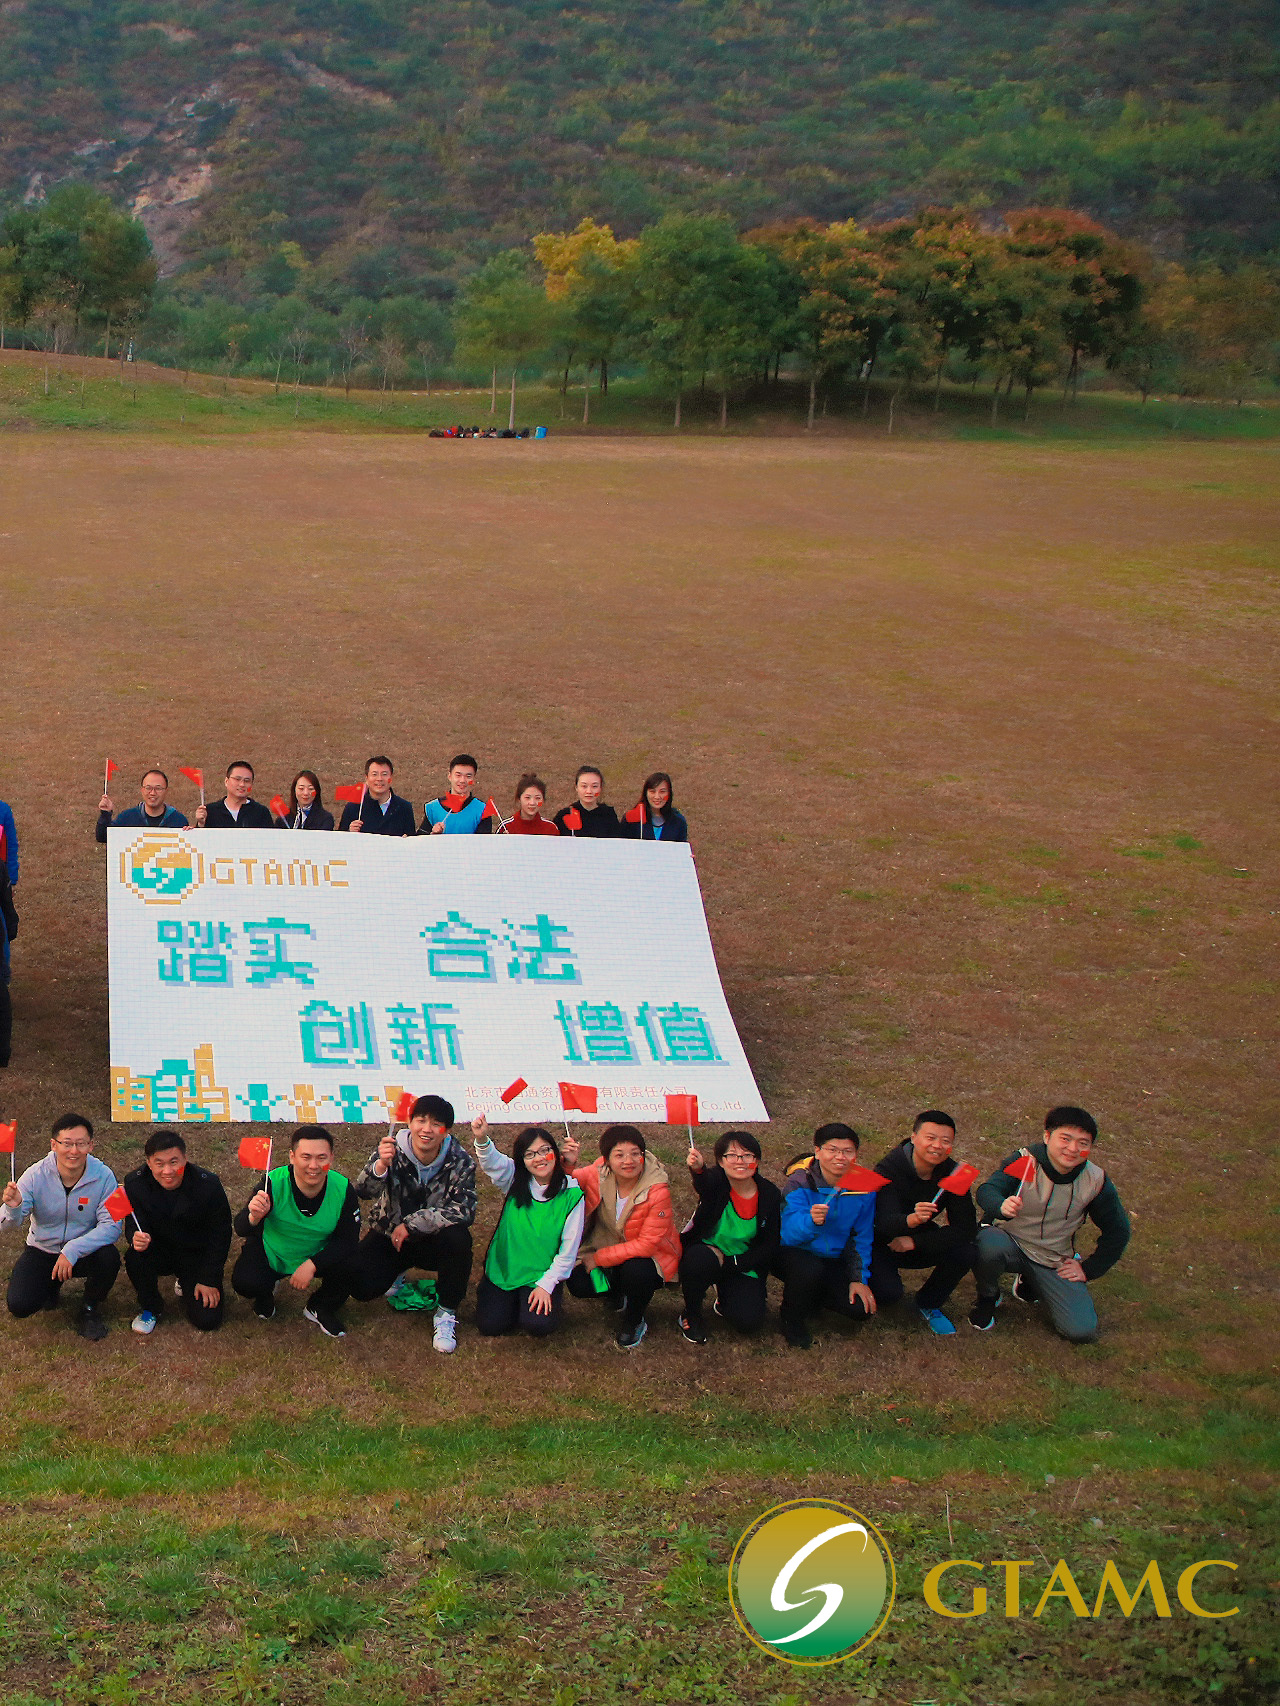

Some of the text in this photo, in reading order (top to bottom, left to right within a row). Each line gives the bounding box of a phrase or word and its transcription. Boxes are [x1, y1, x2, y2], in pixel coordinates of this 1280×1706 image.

[209, 857, 350, 887] GTAMC
[157, 911, 582, 989] 踏实 合法
[298, 1000, 729, 1070] 创新 增值
[466, 1101, 511, 1114] Beijing
[513, 1101, 540, 1112] Guo
